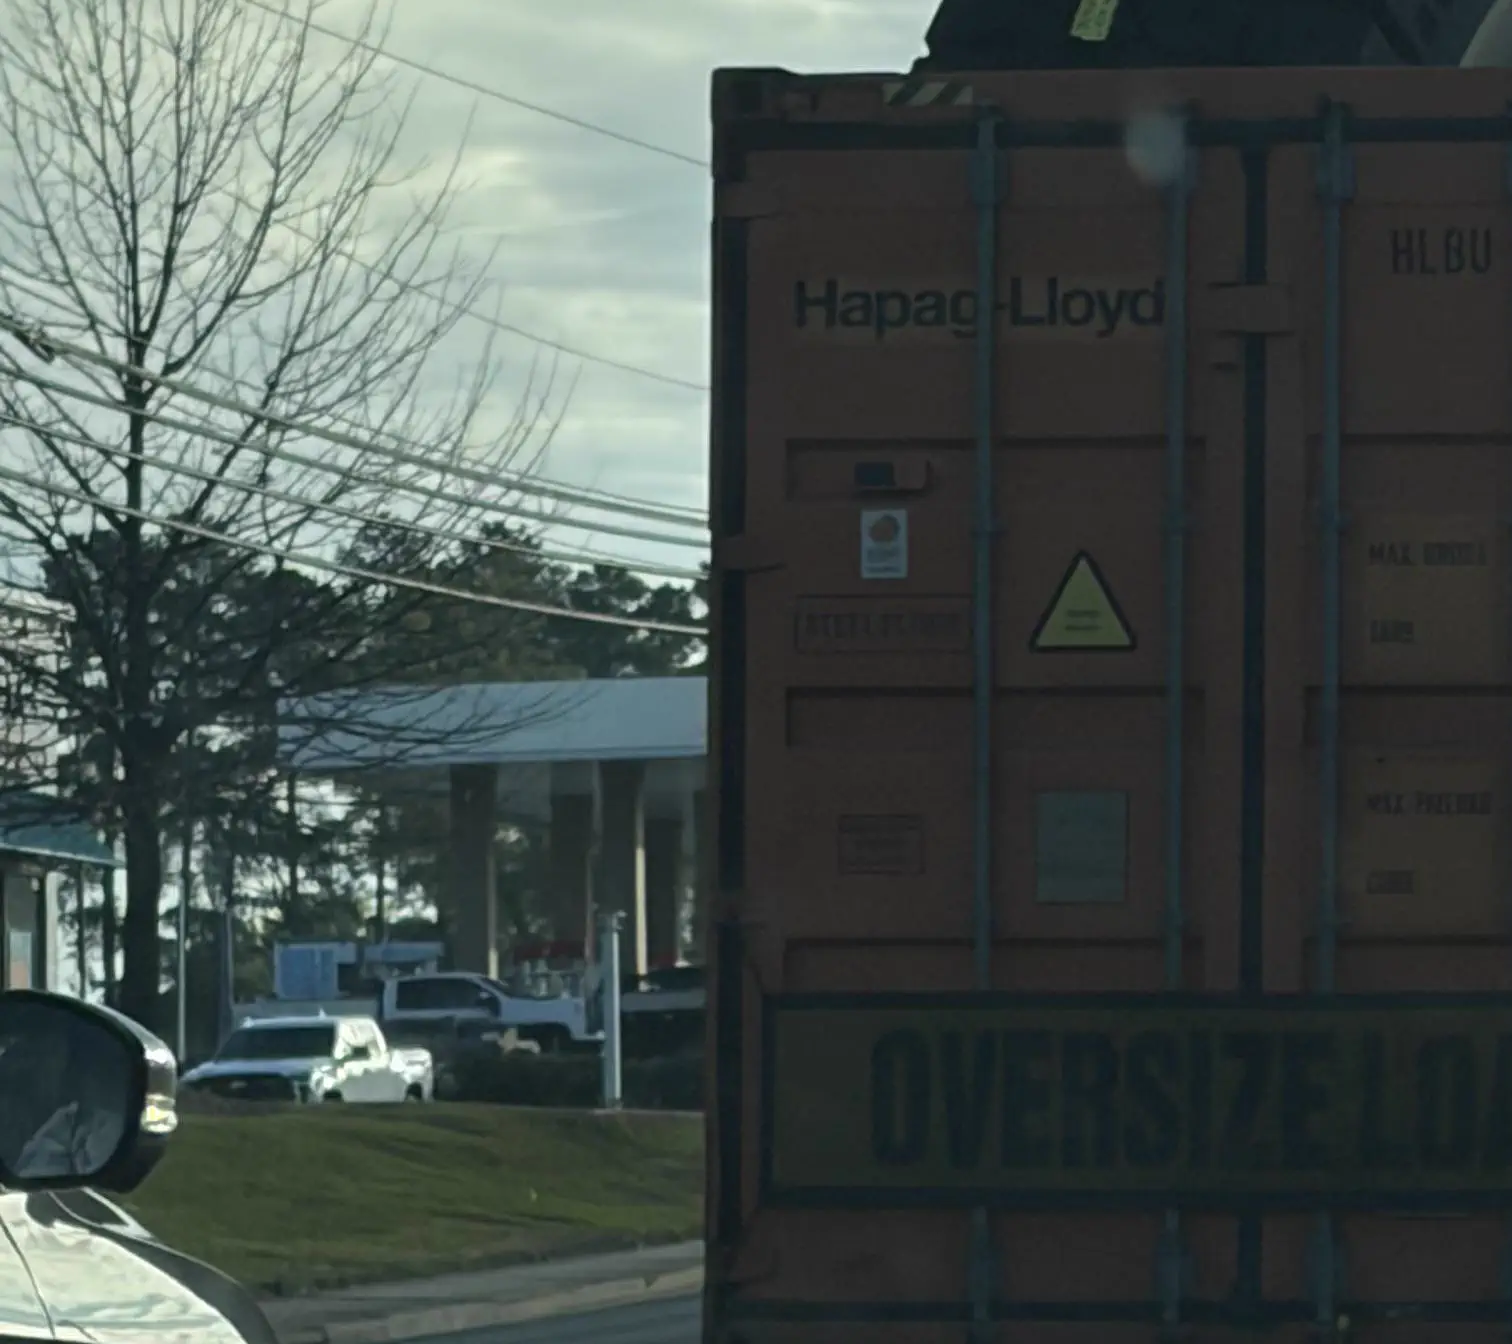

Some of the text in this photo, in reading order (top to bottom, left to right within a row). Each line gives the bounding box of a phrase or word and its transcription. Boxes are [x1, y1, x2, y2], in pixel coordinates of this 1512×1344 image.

[1390, 226, 1493, 274] HLBU
[794, 276, 1166, 340] Hapag-Lloyd
[871, 1029, 1335, 1171] OVERSIZE
